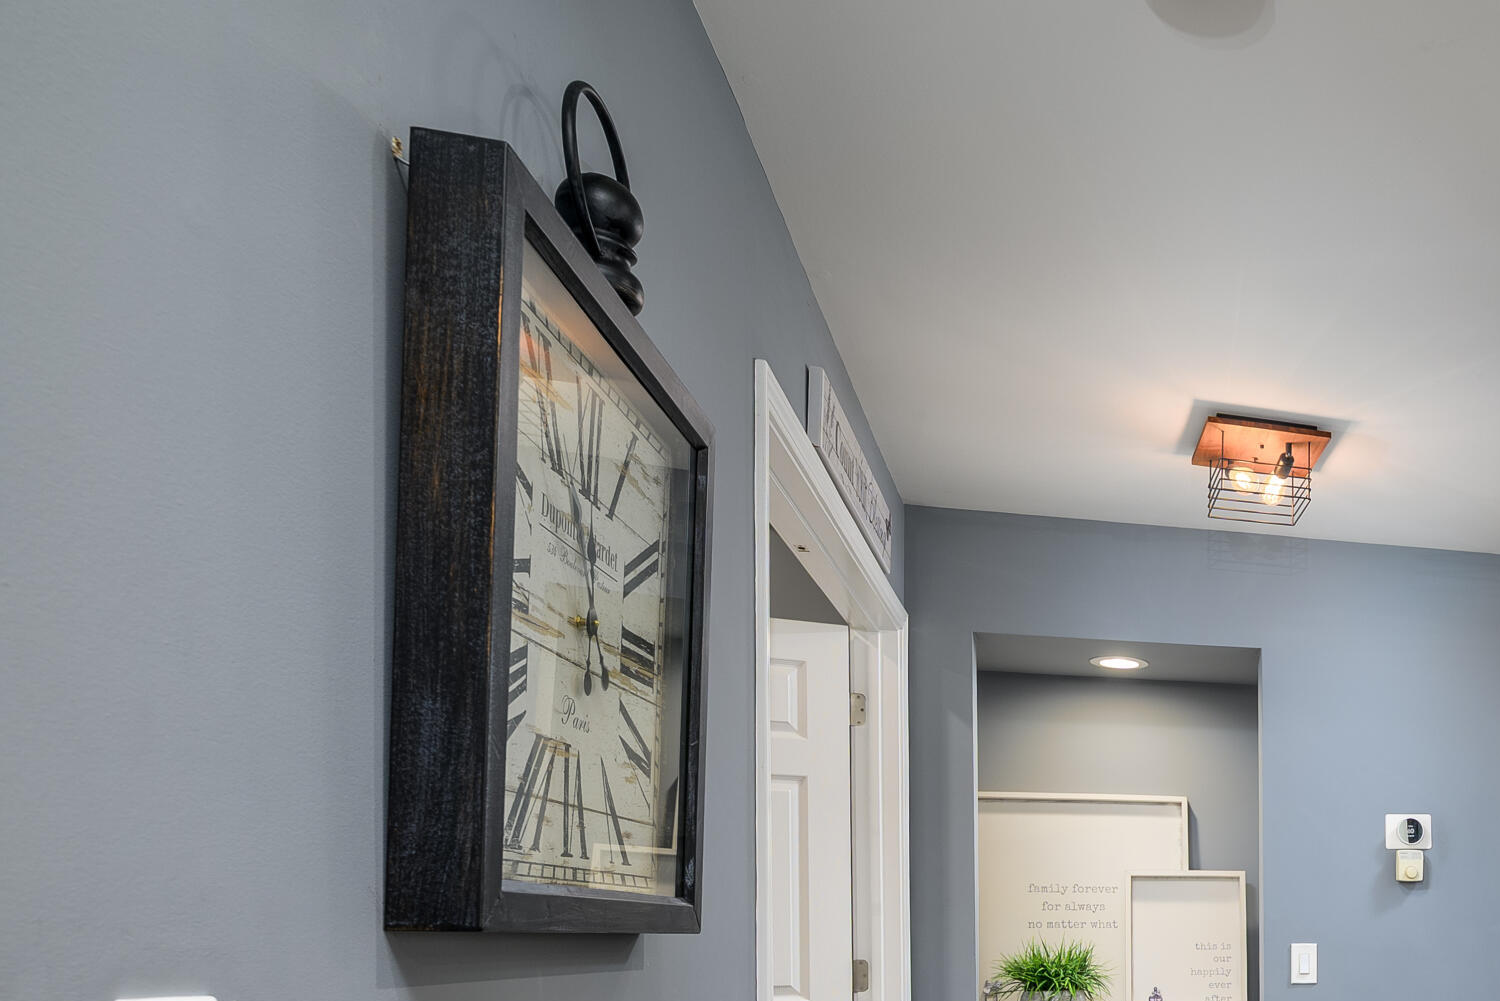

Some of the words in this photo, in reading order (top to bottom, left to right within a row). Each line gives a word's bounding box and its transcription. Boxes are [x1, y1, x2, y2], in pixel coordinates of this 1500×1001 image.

[594, 535, 619, 573] ardet
[560, 695, 591, 733] Paris
[1028, 883, 1068, 895] family
[1073, 883, 1119, 894] forever
[1041, 901, 1061, 911] for
[1064, 901, 1106, 913] always
[1028, 920, 1043, 929] no
[1046, 920, 1087, 929] matter
[1090, 919, 1119, 929] what
[1195, 942, 1217, 951] this
[1220, 942, 1232, 951] is
[1213, 955, 1232, 963] our
[1190, 967, 1232, 978] happily
[1208, 981, 1232, 989] ever
